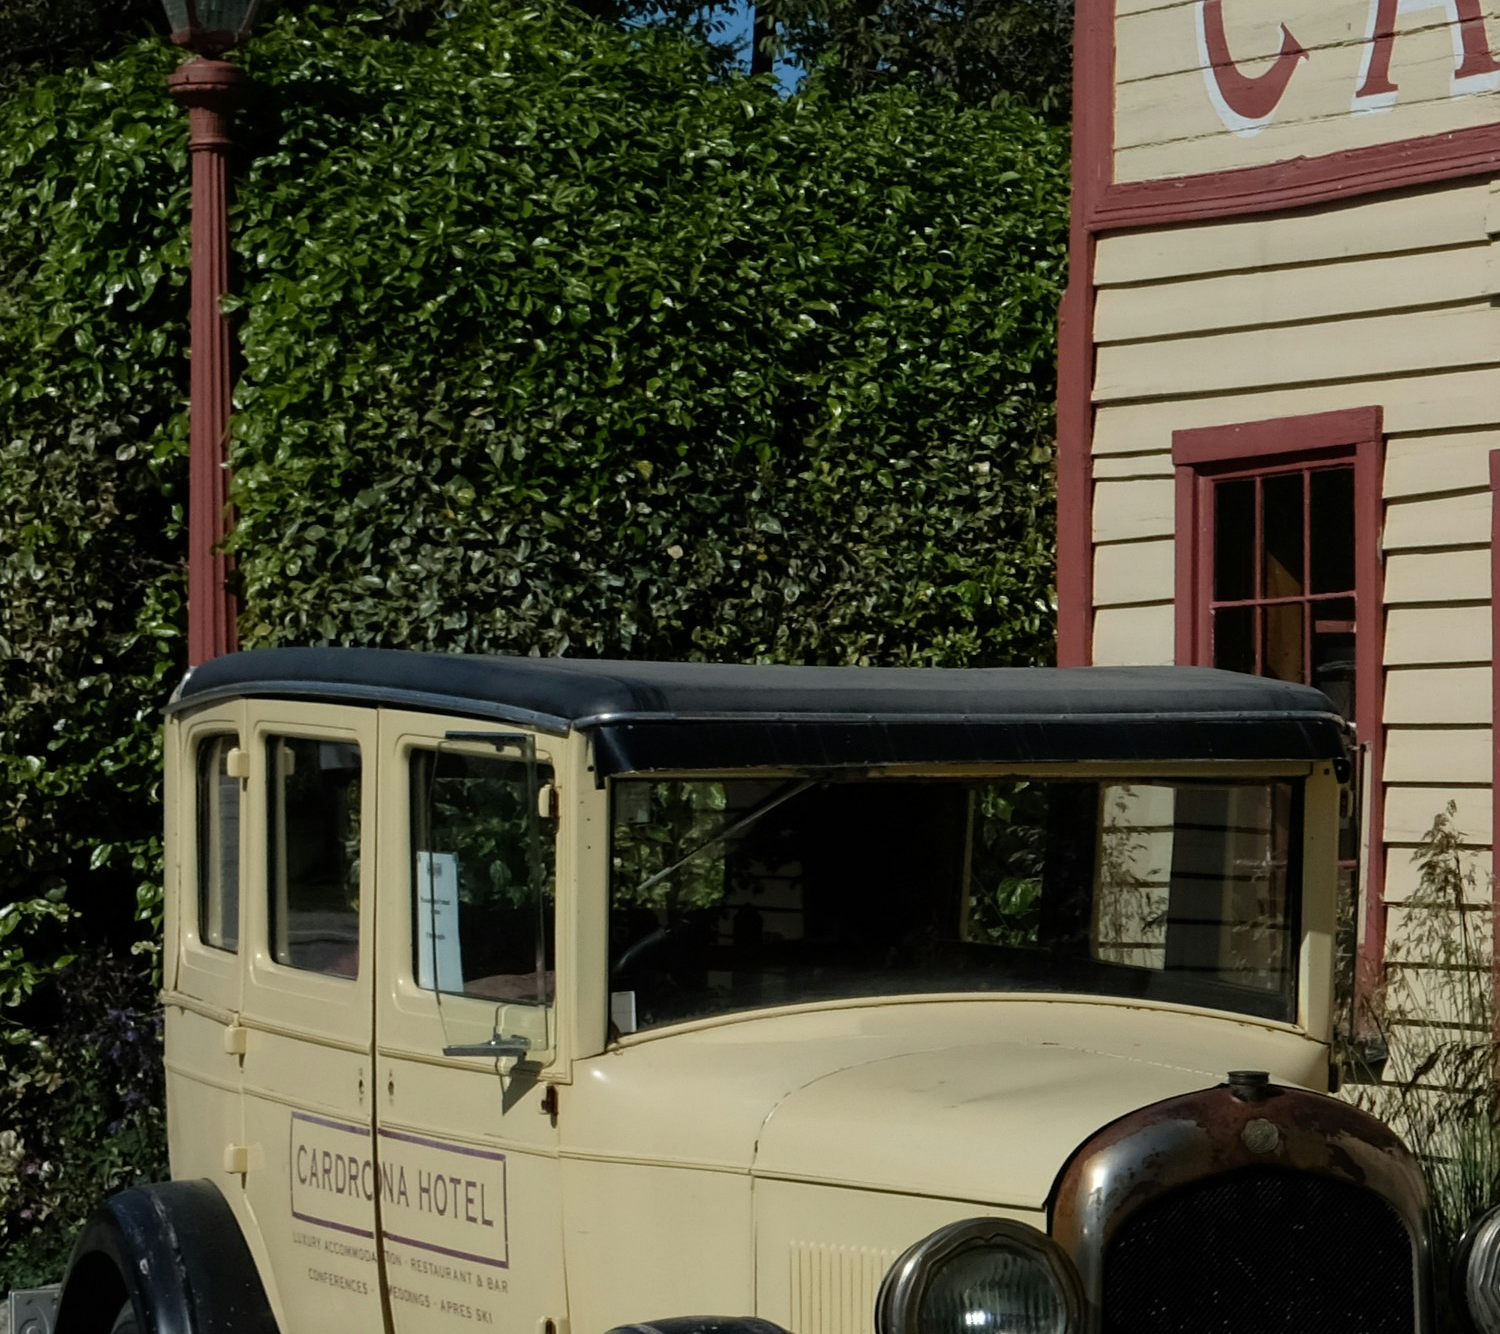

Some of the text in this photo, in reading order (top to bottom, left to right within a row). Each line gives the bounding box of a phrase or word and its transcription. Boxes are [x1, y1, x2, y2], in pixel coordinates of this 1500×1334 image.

[297, 1144, 494, 1228] CARDRONA HOTEL
[410, 1257, 472, 1285] RESTAURANT
[487, 1276, 509, 1294] BAR
